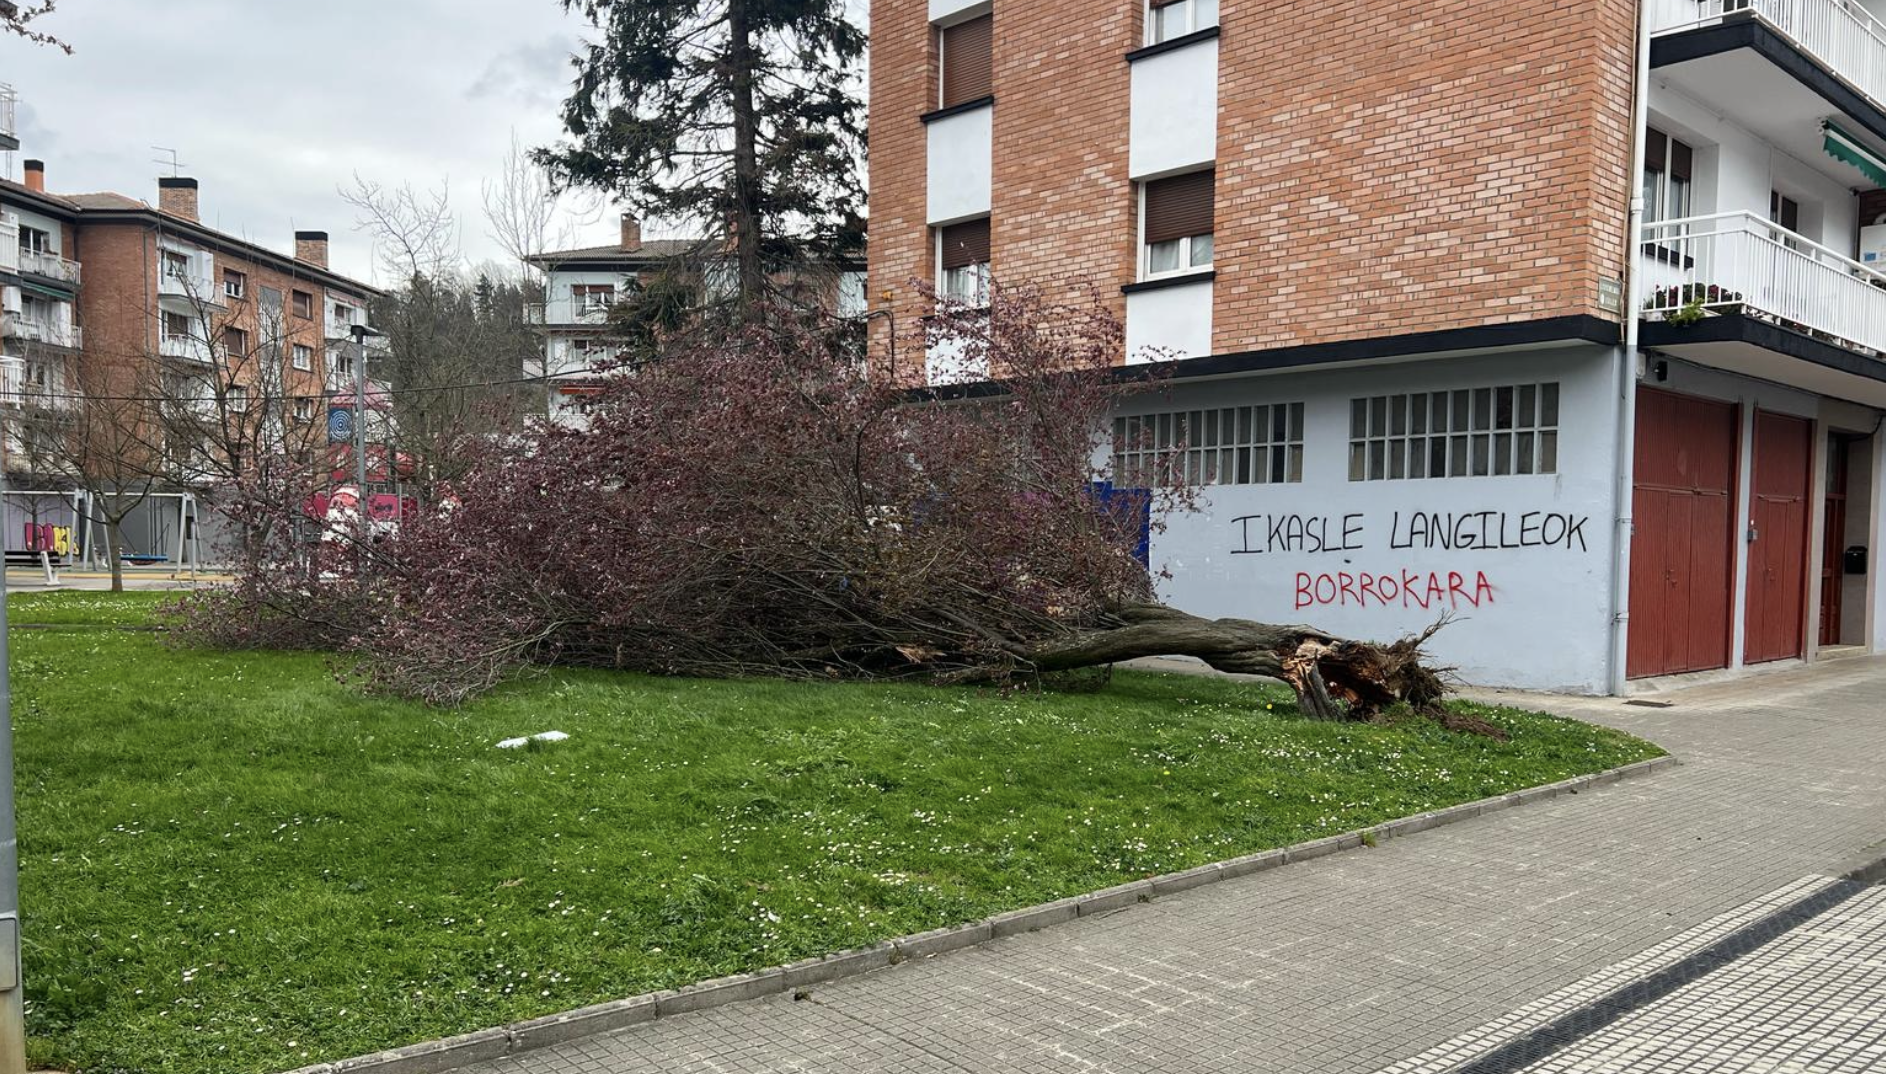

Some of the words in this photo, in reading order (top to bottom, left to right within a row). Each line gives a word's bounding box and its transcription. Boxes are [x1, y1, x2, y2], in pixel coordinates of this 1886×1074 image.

[1231, 513, 1364, 554] IKASLE
[1390, 511, 1589, 552] LANGILEOK
[1295, 568, 1495, 610] BORROKARA
